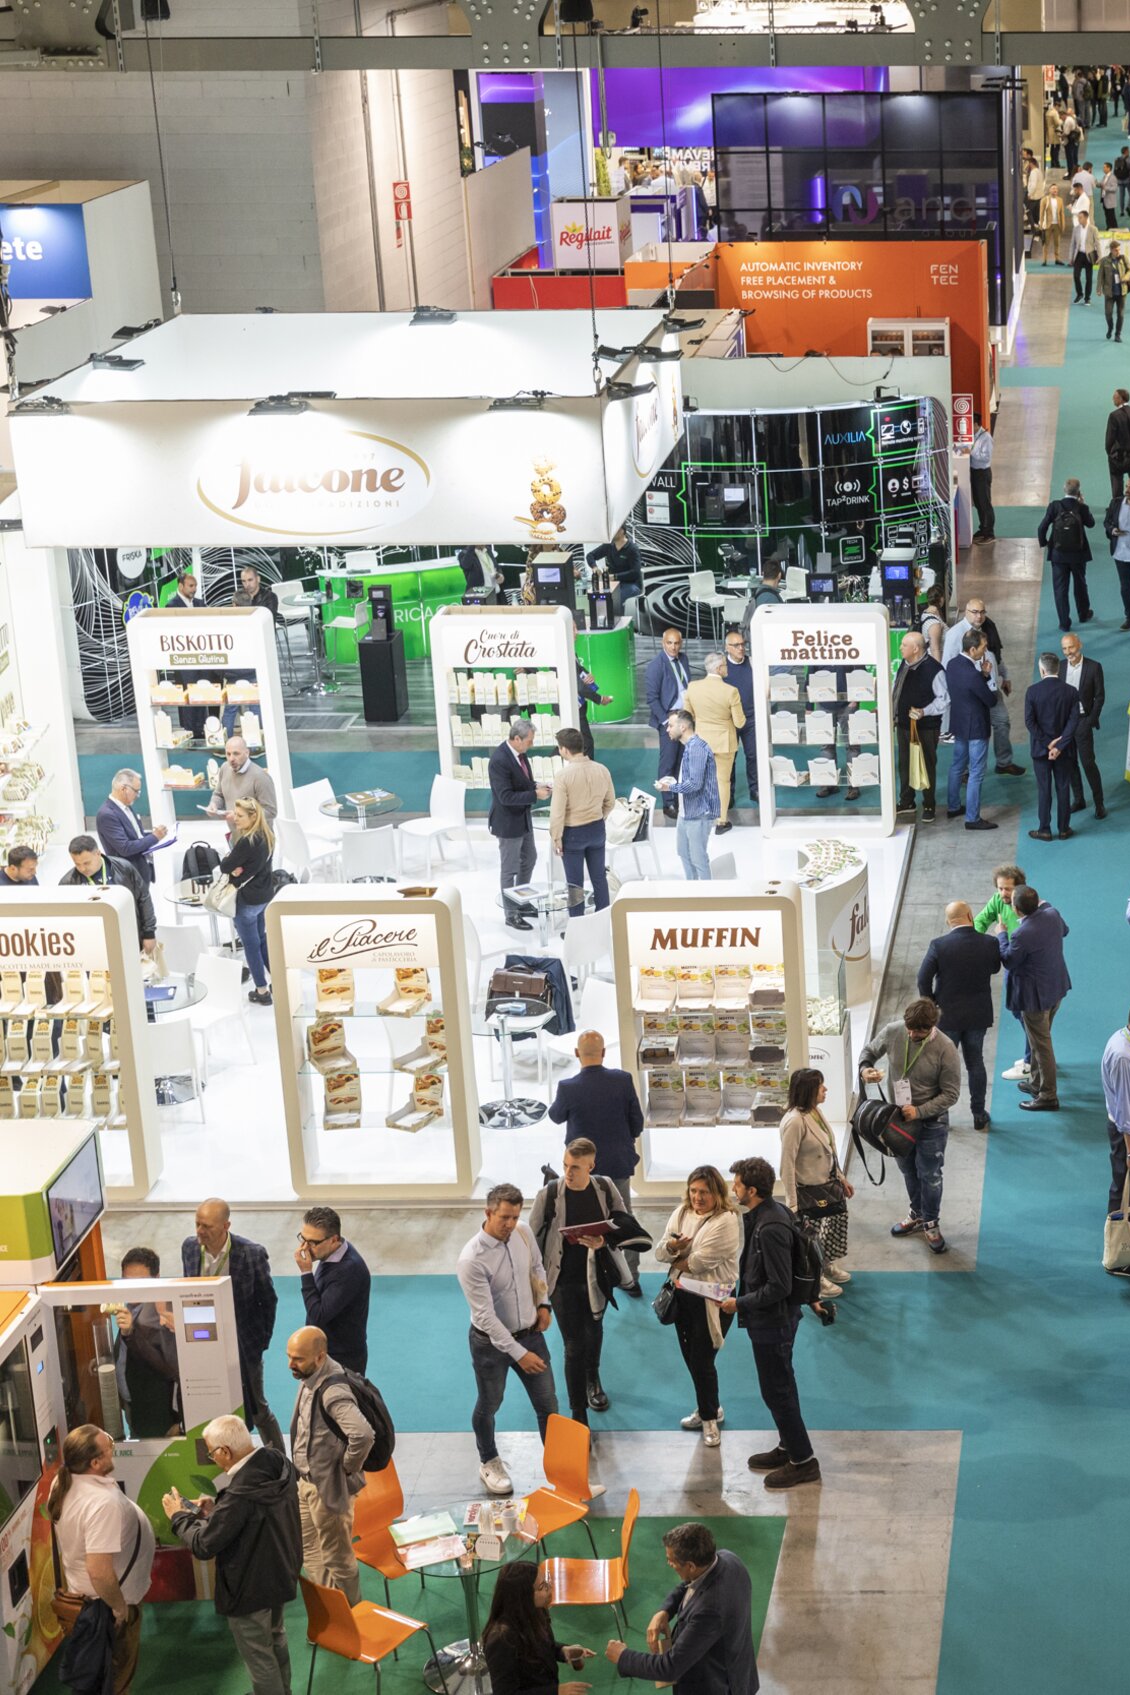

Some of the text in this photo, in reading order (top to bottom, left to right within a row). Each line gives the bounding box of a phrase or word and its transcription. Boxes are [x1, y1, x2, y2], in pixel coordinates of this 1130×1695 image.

[740, 261, 863, 272] AUTOMATIC INVENTORY
[930, 264, 959, 274] FEN
[741, 275, 836, 286] FREE PLACEMENT &
[930, 275, 959, 286] TEC
[741, 288, 873, 300] BROWSING OF PRODUCTS
[160, 634, 234, 652] BISKOTTO
[791, 630, 853, 646] Felice
[464, 639, 537, 665] Crostata
[780, 643, 860, 660] mattino
[173, 655, 197, 665] Senza
[329, 918, 418, 955] Piacere
[650, 927, 761, 950] MUFFIN
